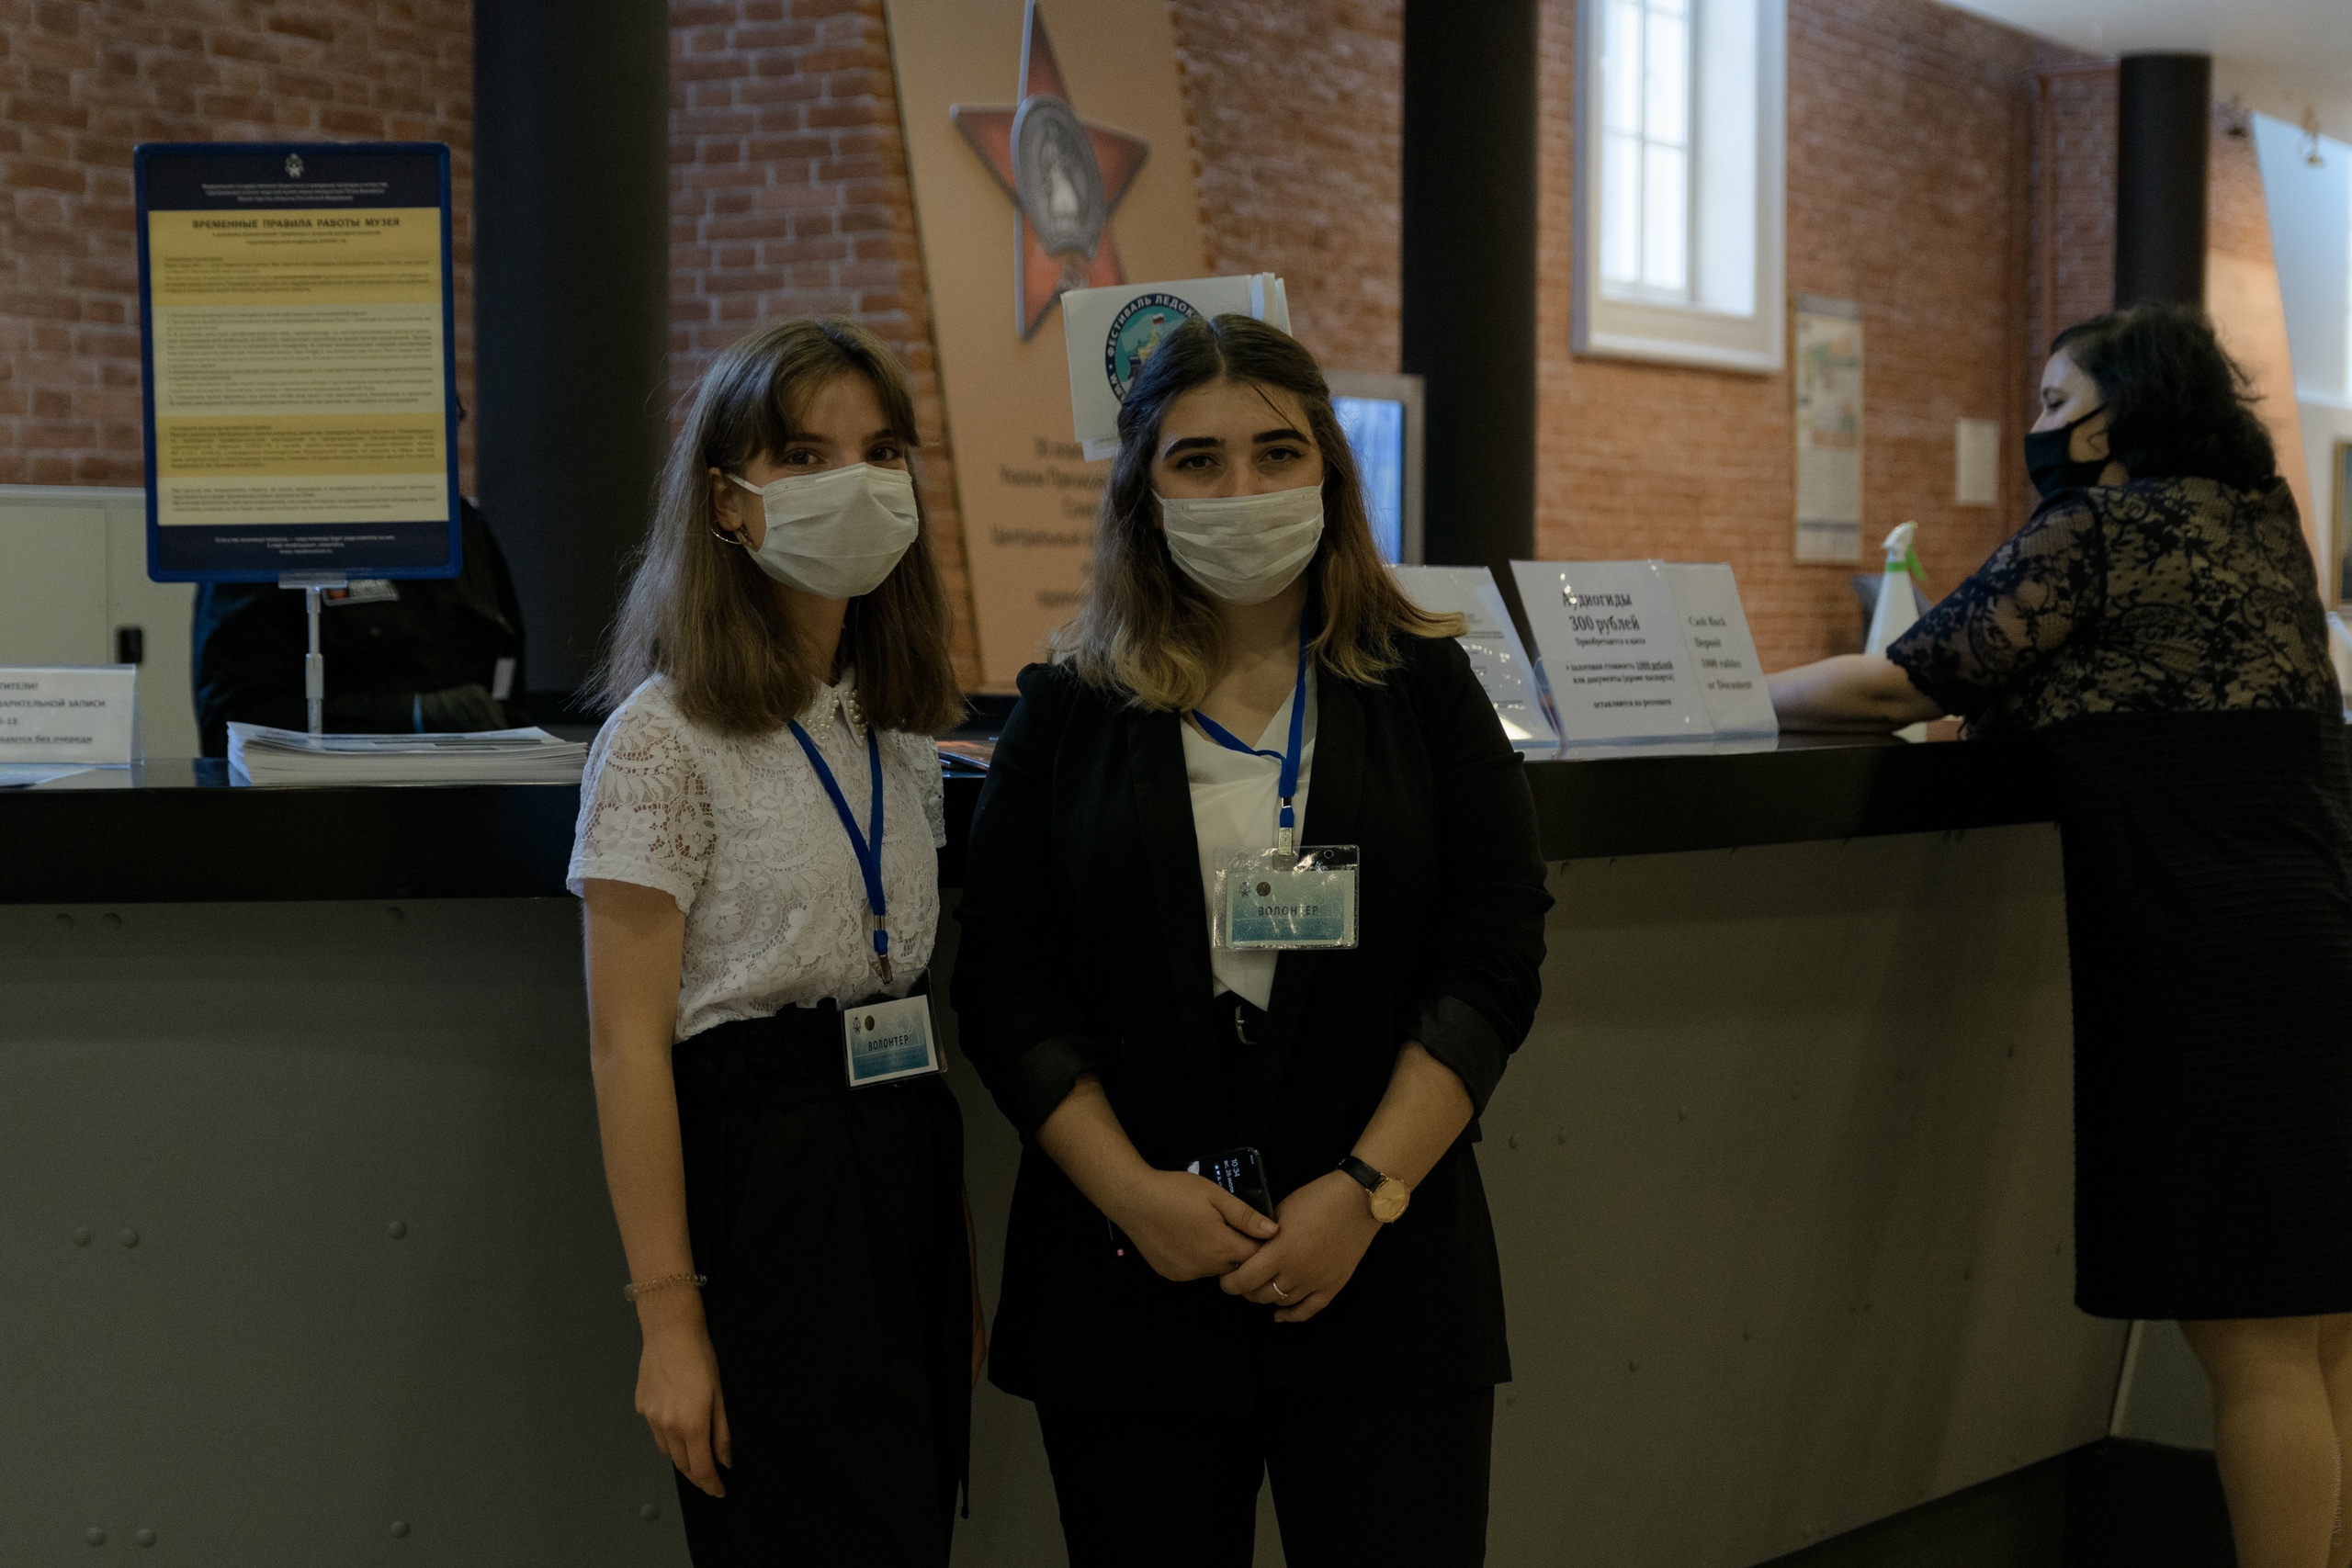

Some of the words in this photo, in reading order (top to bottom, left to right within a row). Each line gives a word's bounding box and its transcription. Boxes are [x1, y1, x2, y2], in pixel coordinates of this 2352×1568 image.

[192, 219, 258, 229] ВРЕМЕННЫЕ
[262, 218, 312, 228] ПРАВИЛА
[317, 218, 360, 227] РАБОТЫ
[365, 217, 400, 227] МУЗЕЯ
[1106, 296, 1152, 357] ФЕСТИВАЛЬ
[1155, 294, 1194, 319] ЛЕДОК
[1569, 615, 1594, 631] 300
[1595, 614, 1640, 635] рублей
[68, 699, 106, 707] ЗАПИСИ
[34, 734, 51, 743] без
[52, 736, 93, 744] очереди
[868, 1035, 909, 1051] ВОЛОНТЕР
[1231, 1158, 1240, 1177] 10:34
